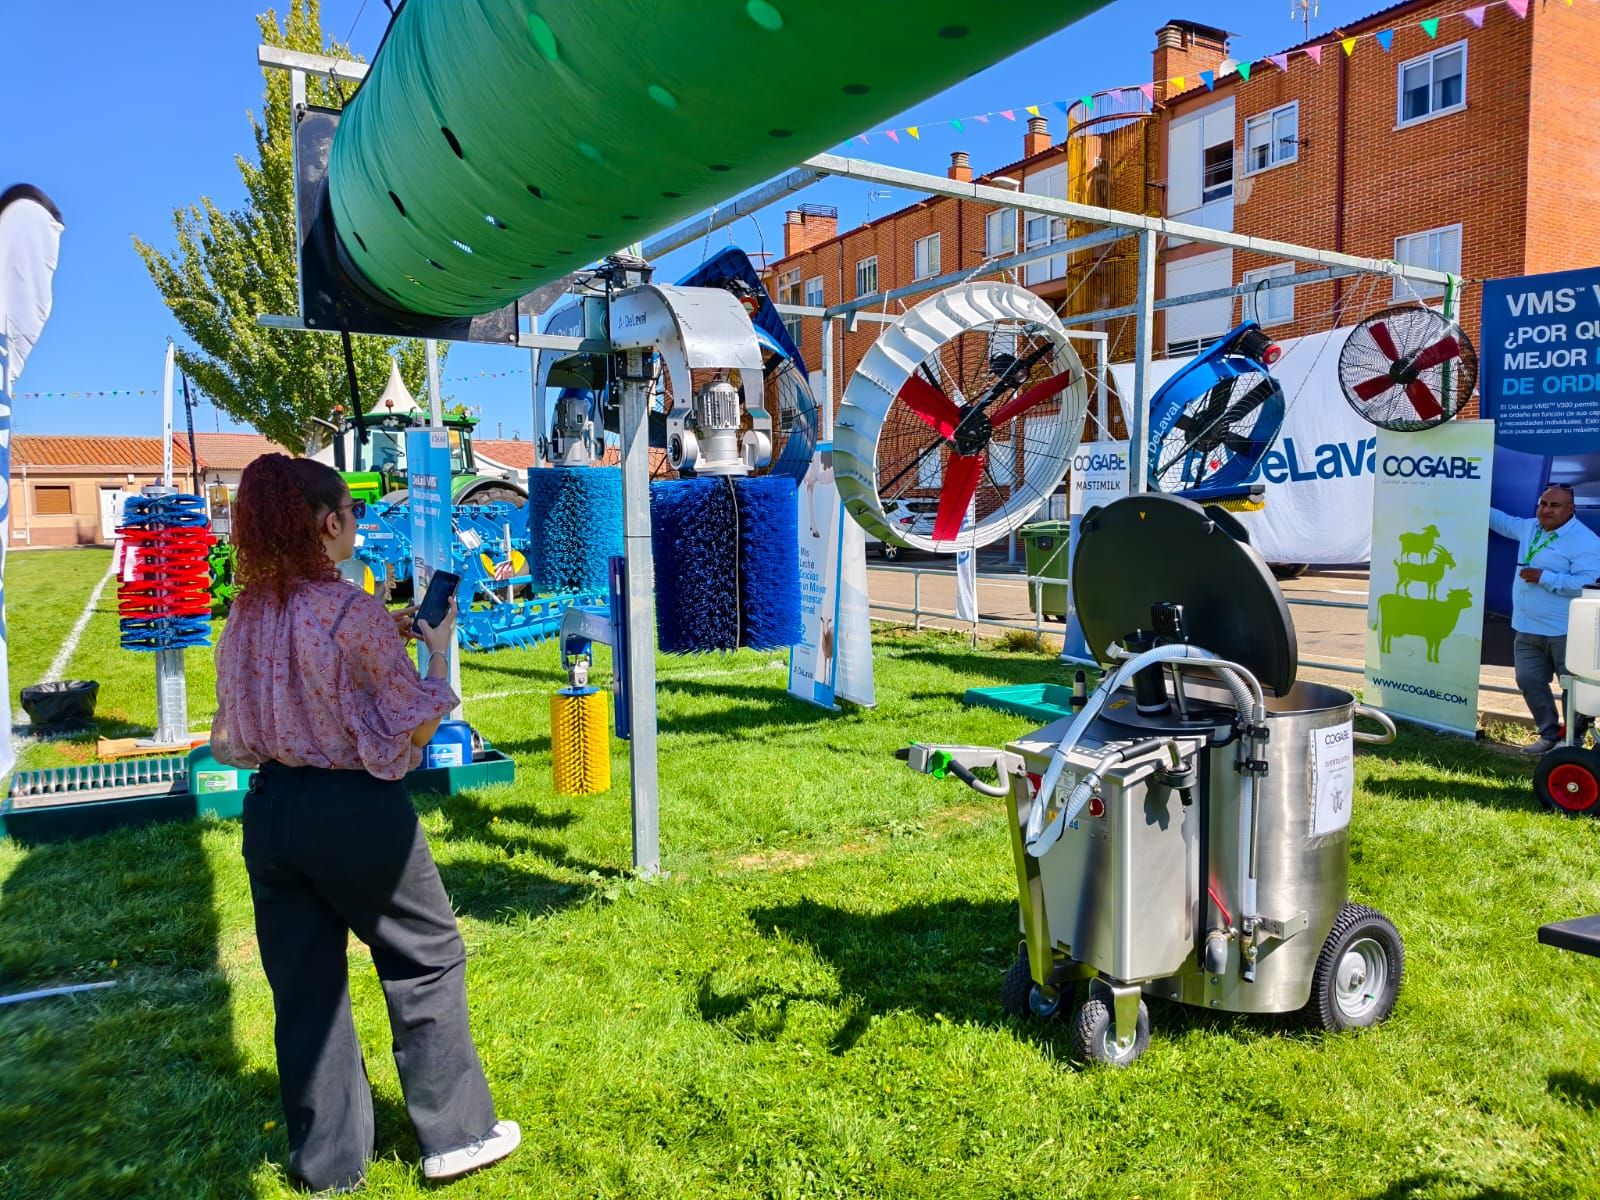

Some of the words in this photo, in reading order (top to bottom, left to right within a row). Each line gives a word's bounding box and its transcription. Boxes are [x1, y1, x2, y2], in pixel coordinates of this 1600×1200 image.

[1504, 324, 1567, 349] ¿POR
[1504, 348, 1587, 370] MEJOR
[1503, 377, 1535, 395] DE
[1149, 401, 1181, 454] DeLaval
[1073, 452, 1127, 472] COGABE
[1383, 455, 1482, 479] COGABE
[1076, 480, 1121, 490] MASTIMILK
[1372, 676, 1468, 706] WWW.COGABE.COM
